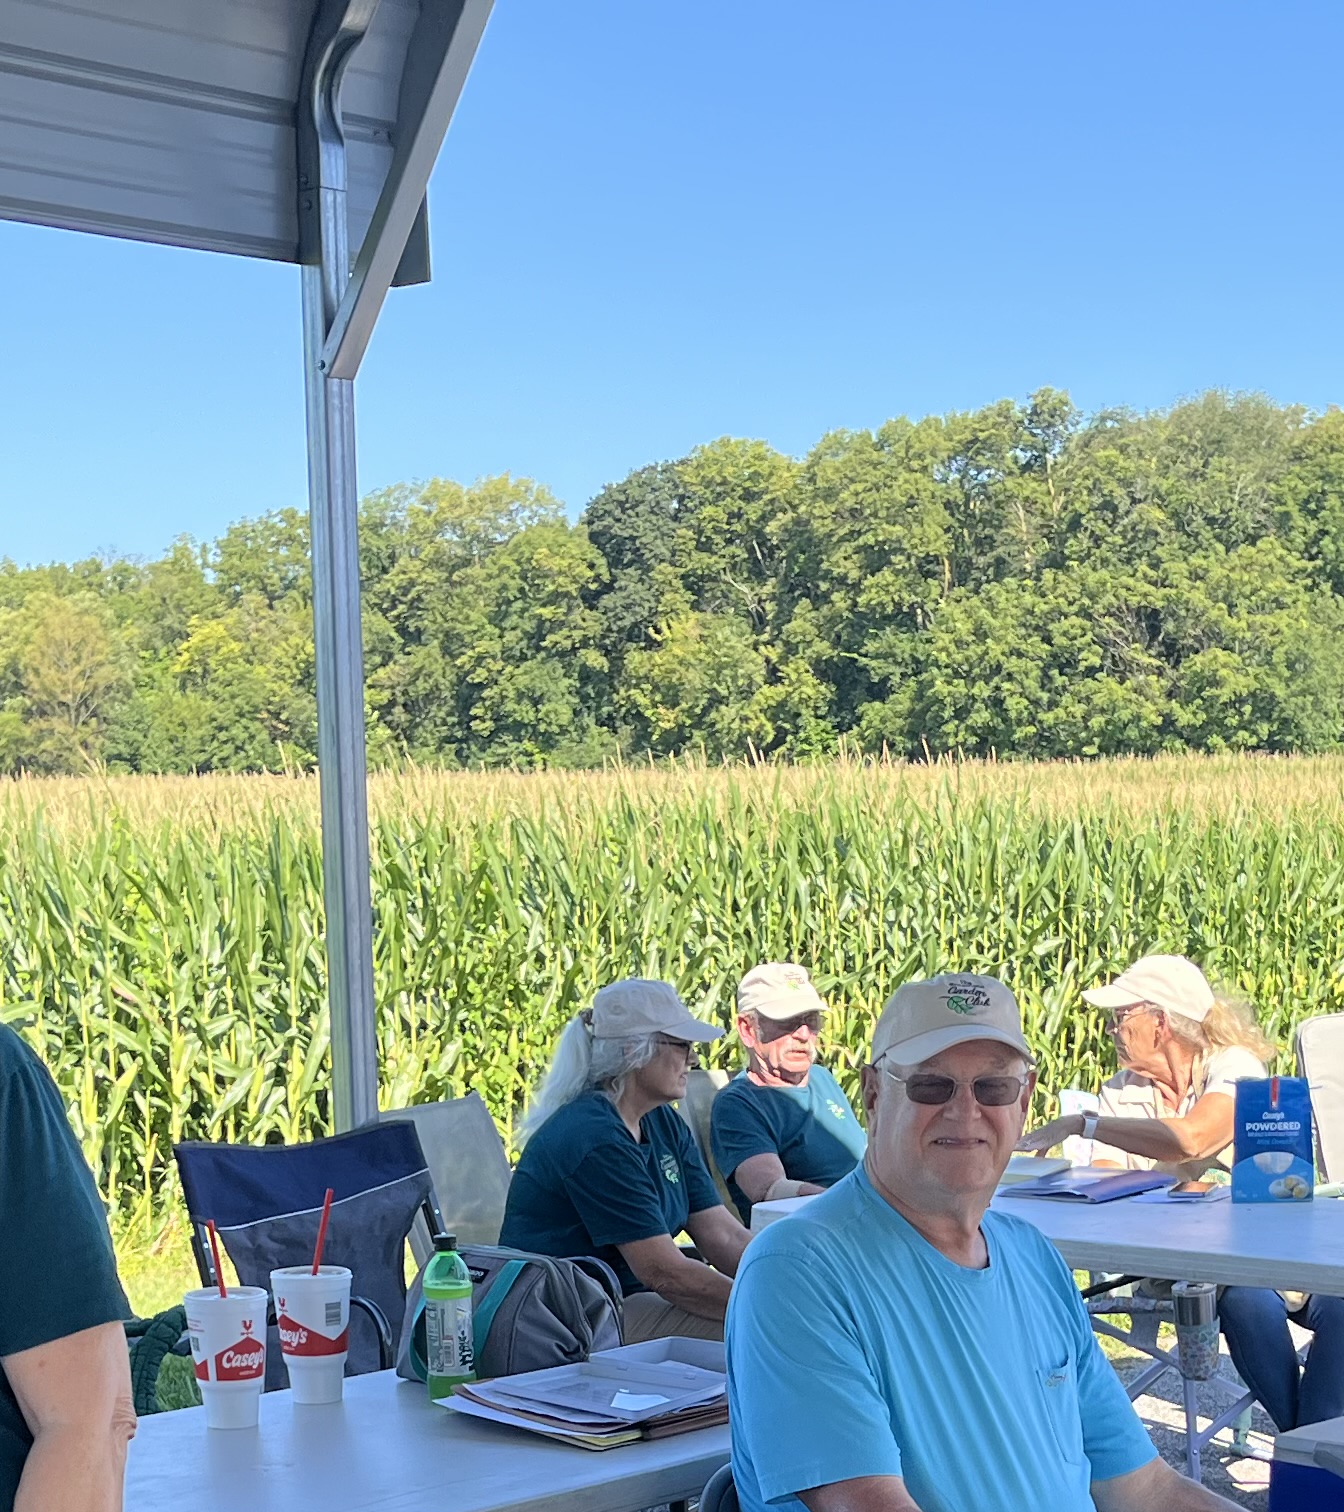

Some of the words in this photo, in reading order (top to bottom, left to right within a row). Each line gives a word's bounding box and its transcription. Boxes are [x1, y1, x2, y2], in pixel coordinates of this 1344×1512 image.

[947, 986, 987, 997] Garden
[965, 996, 991, 1007] Club
[1246, 1121, 1301, 1132] POWDERED
[222, 1347, 265, 1369] Casey's
